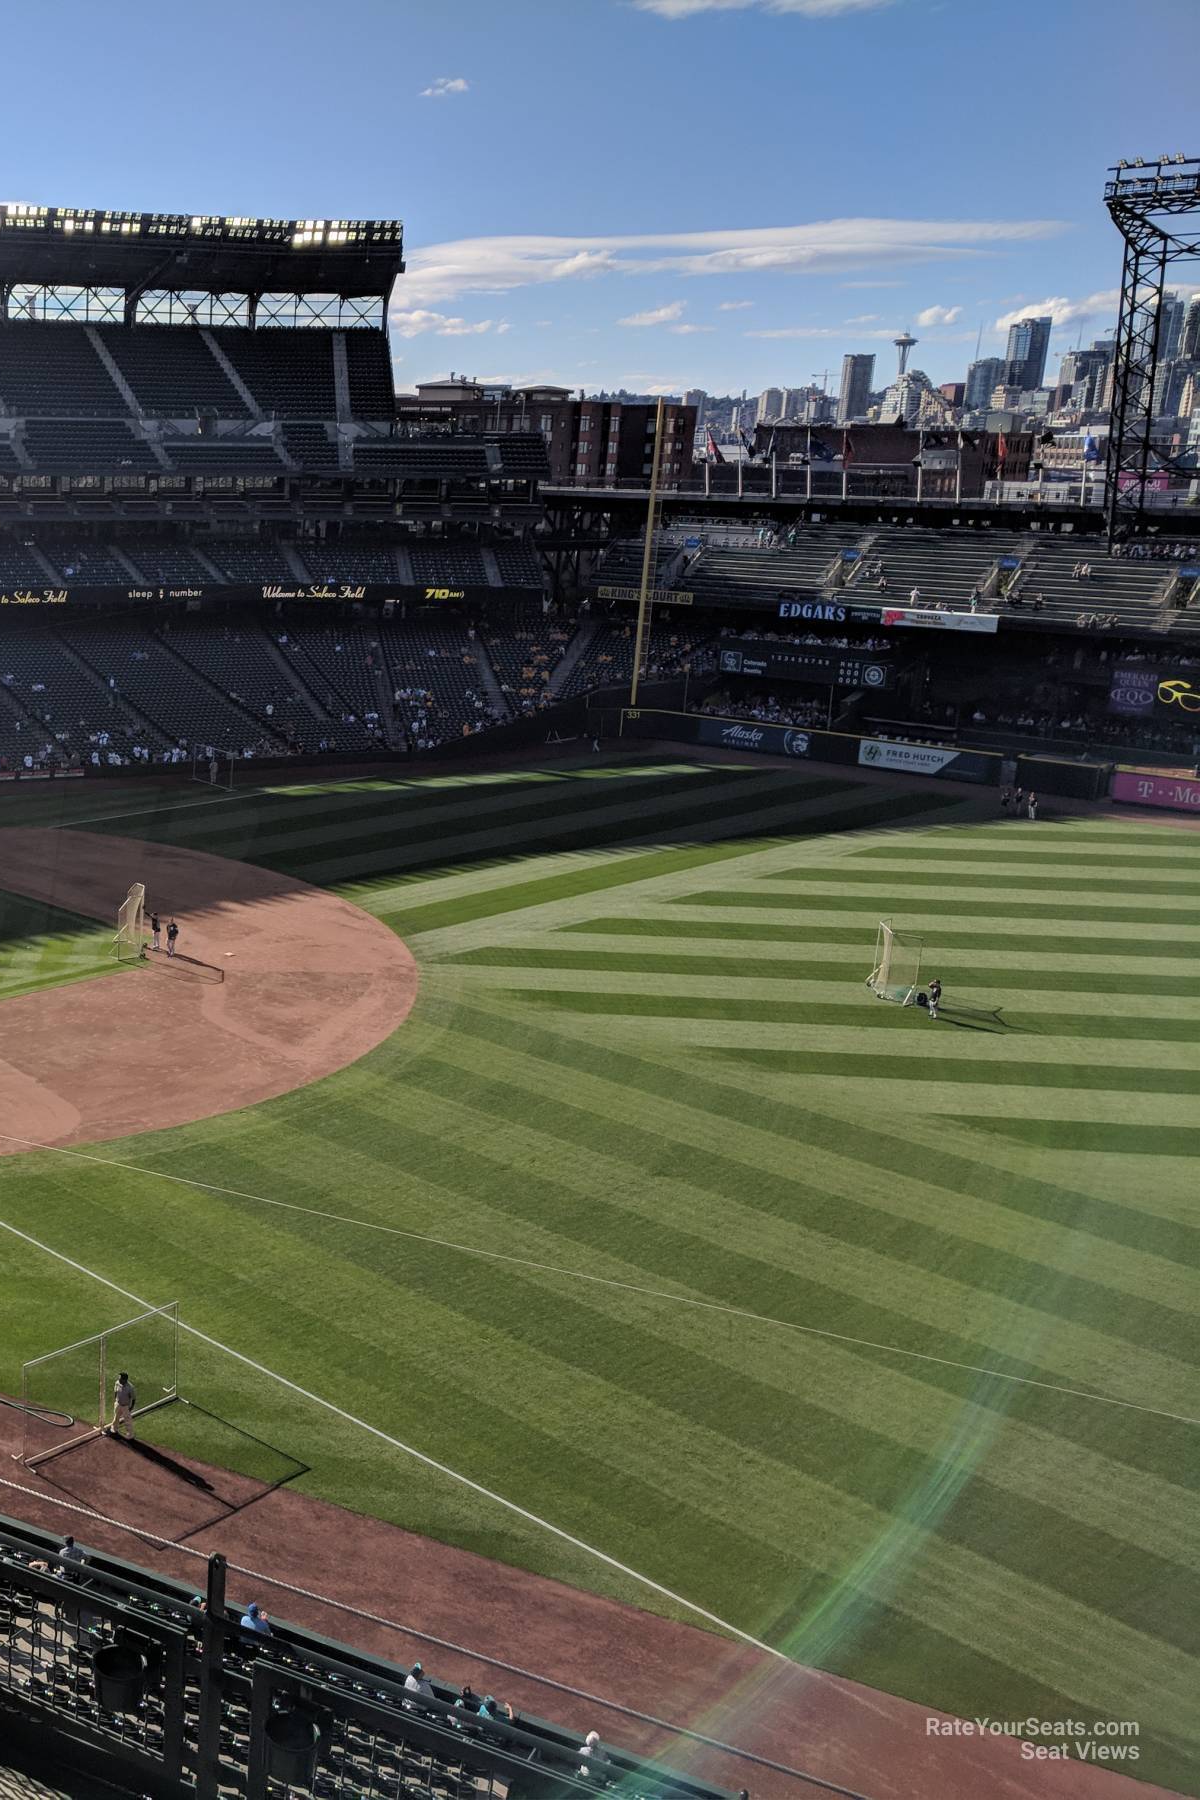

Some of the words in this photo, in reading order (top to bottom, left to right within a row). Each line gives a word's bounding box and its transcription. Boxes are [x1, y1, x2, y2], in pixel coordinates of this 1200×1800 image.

[1, 594, 9, 604] to
[10, 590, 40, 604] Safeco
[42, 590, 68, 603] Field
[128, 589, 153, 600] sleep
[169, 588, 203, 597] number
[262, 586, 296, 599] Welcome
[297, 588, 305, 598] to
[306, 585, 337, 598] Safeco
[338, 585, 366, 598] Field
[626, 711, 640, 719] 331
[721, 725, 764, 741] Alaska
[886, 749, 910, 759] FRED
[912, 752, 944, 764] HUTCH
